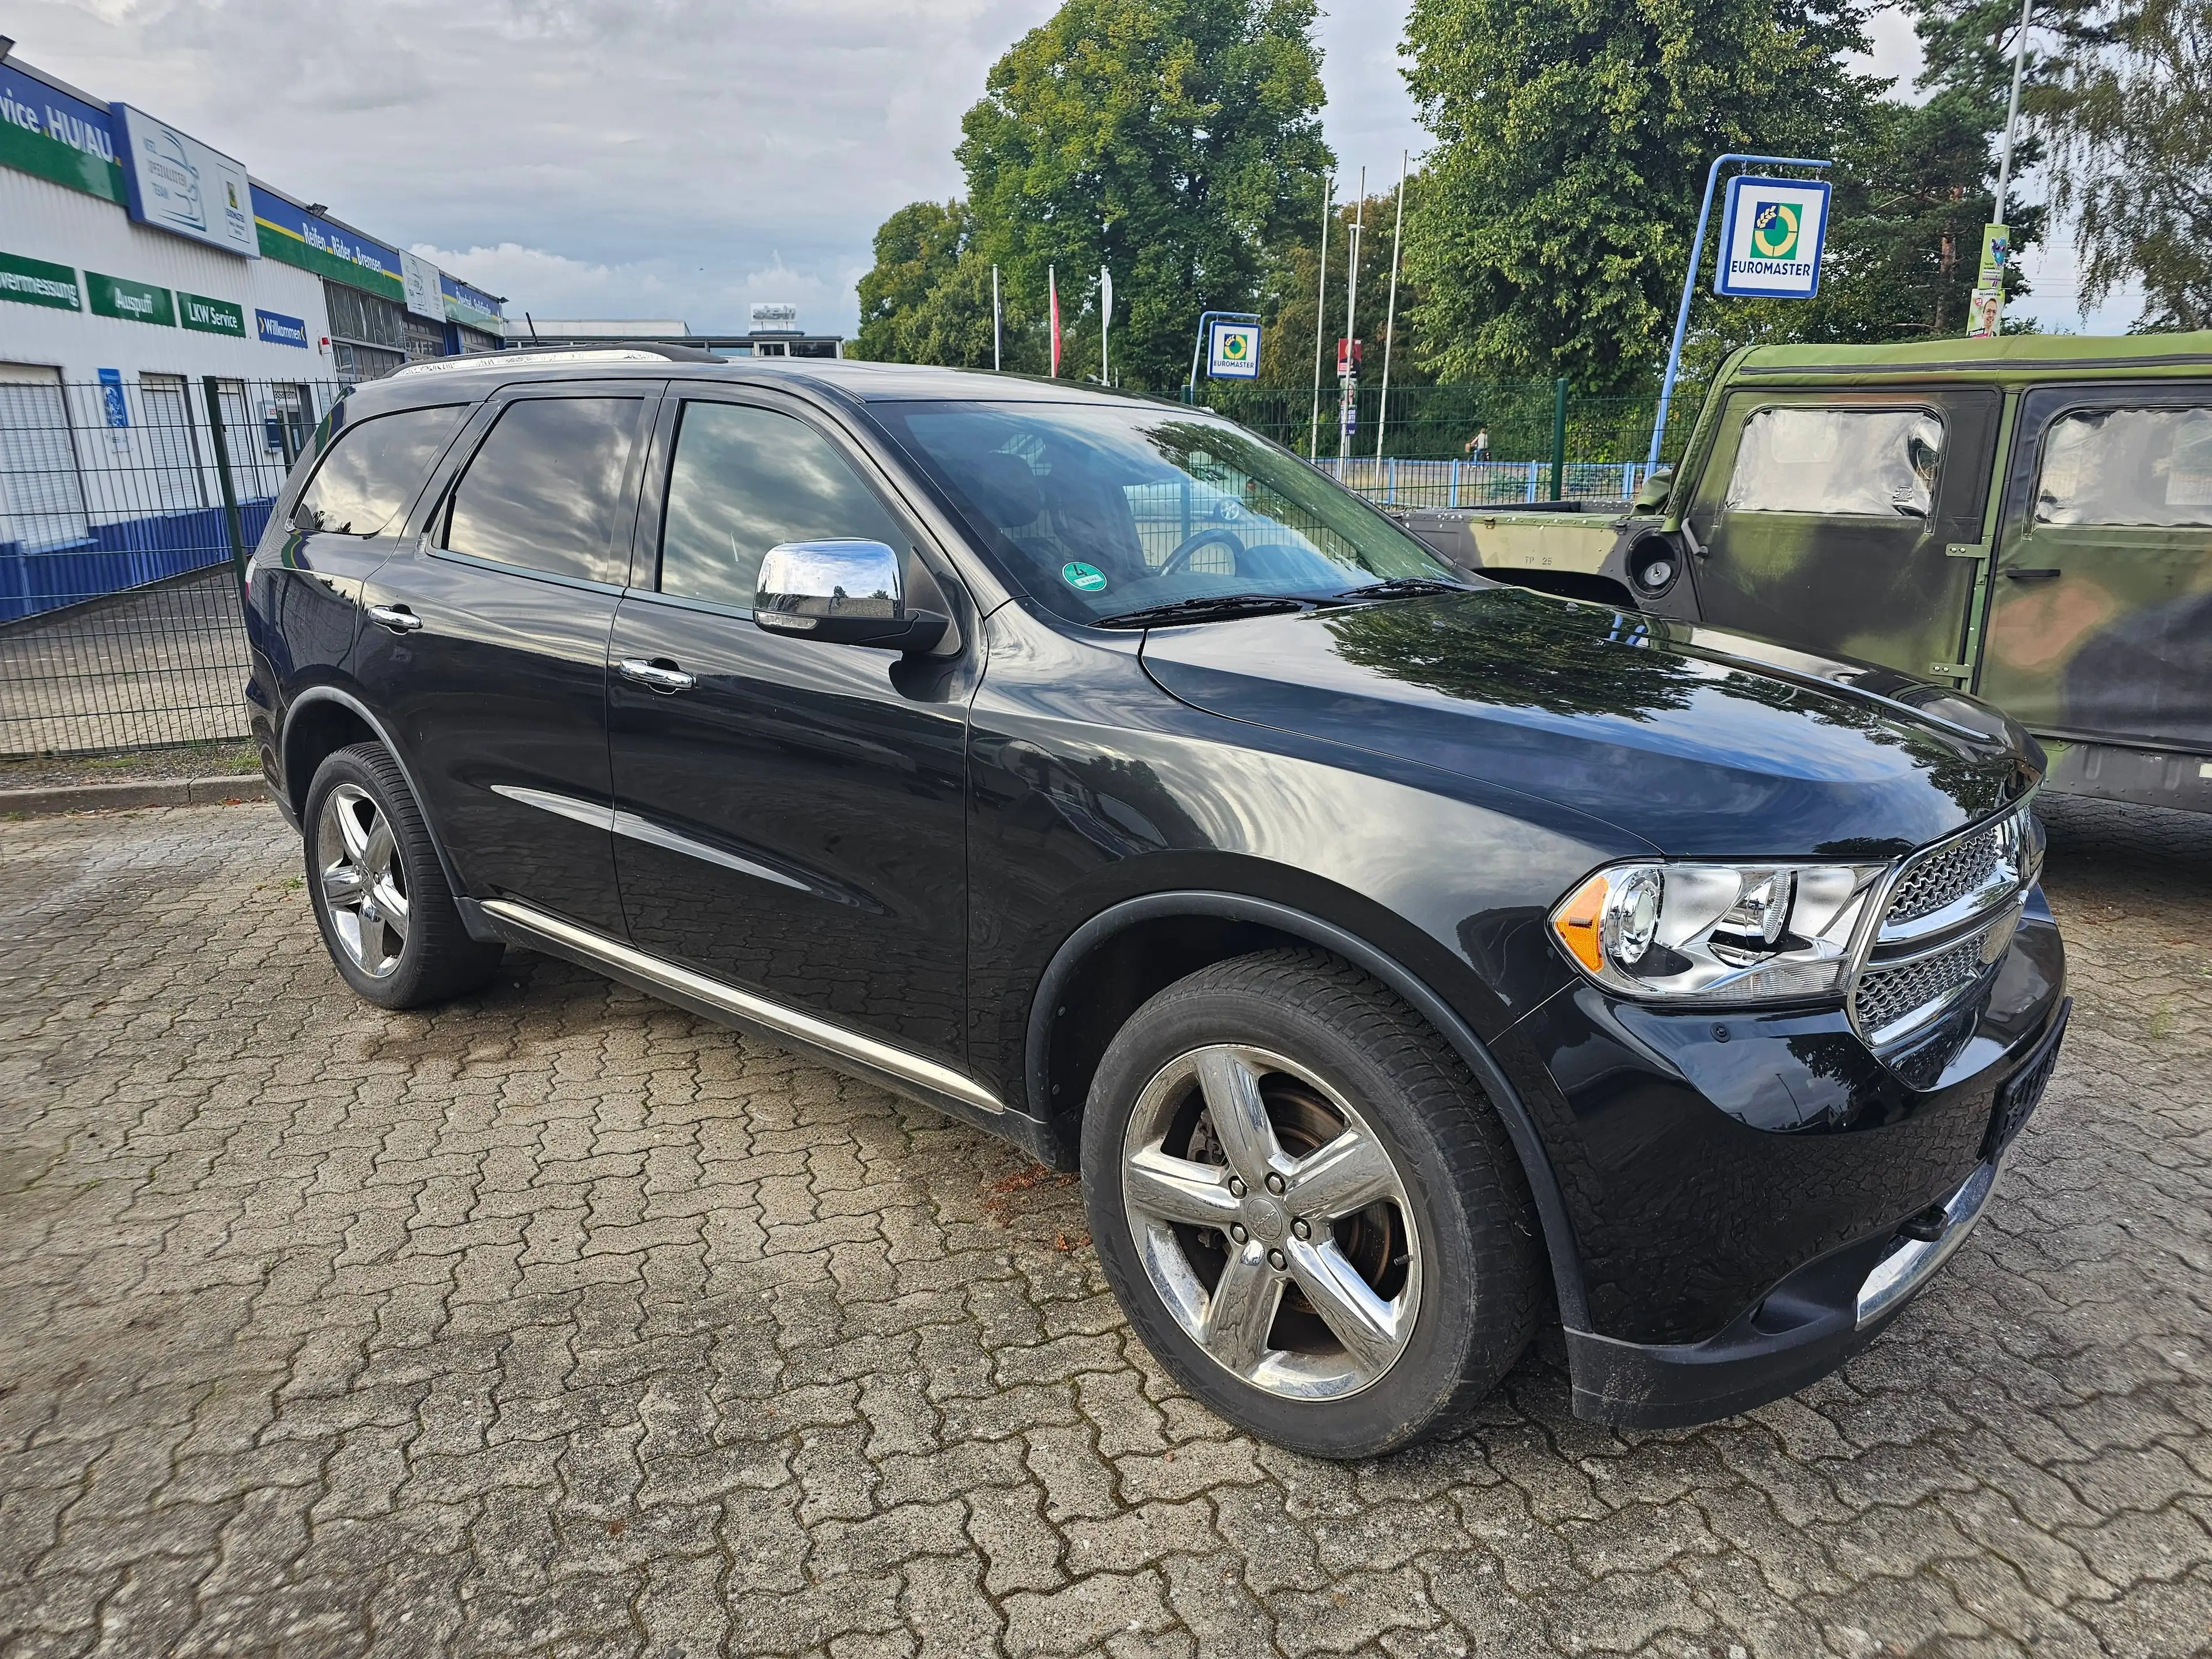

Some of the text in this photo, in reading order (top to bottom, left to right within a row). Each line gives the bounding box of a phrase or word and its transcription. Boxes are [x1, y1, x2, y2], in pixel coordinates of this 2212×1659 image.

[302, 222, 382, 273] Reifen Räder Bremsen
[1731, 260, 1810, 276] EUROMASTER
[115, 287, 153, 317] Auspuff
[187, 302, 238, 328] LKW Service
[264, 317, 302, 340] Willkommen
[1214, 360, 1254, 368] EUROMASTER
[1073, 564, 1088, 576] 4
[1542, 557, 1552, 565] 25
